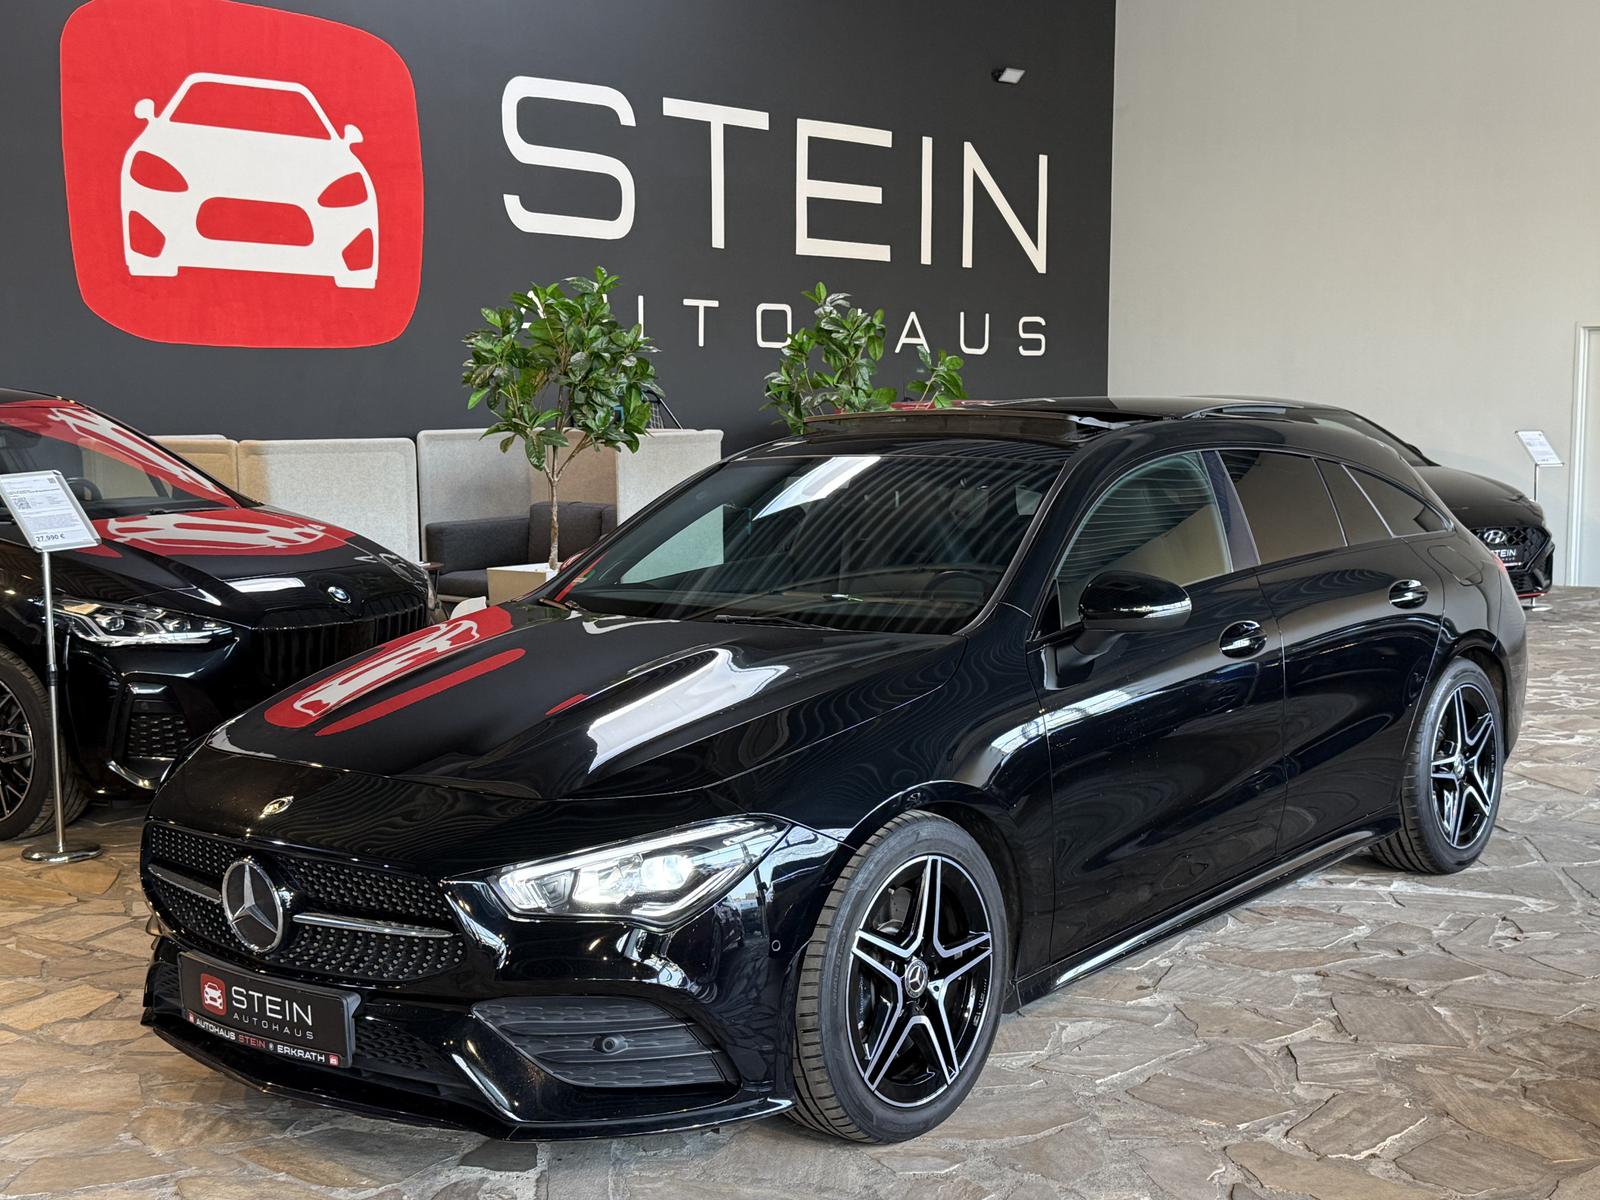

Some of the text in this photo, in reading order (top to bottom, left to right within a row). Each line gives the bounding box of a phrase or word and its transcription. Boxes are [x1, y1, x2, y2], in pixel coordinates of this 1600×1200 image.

[502, 76, 1047, 273] STEIN
[520, 291, 1047, 357] TOAUS
[231, 986, 313, 1026] STEIN
[232, 1012, 314, 1040] AUTOHAUS
[195, 1018, 326, 1063] AUTOHAUS STEIN ERKRATH
